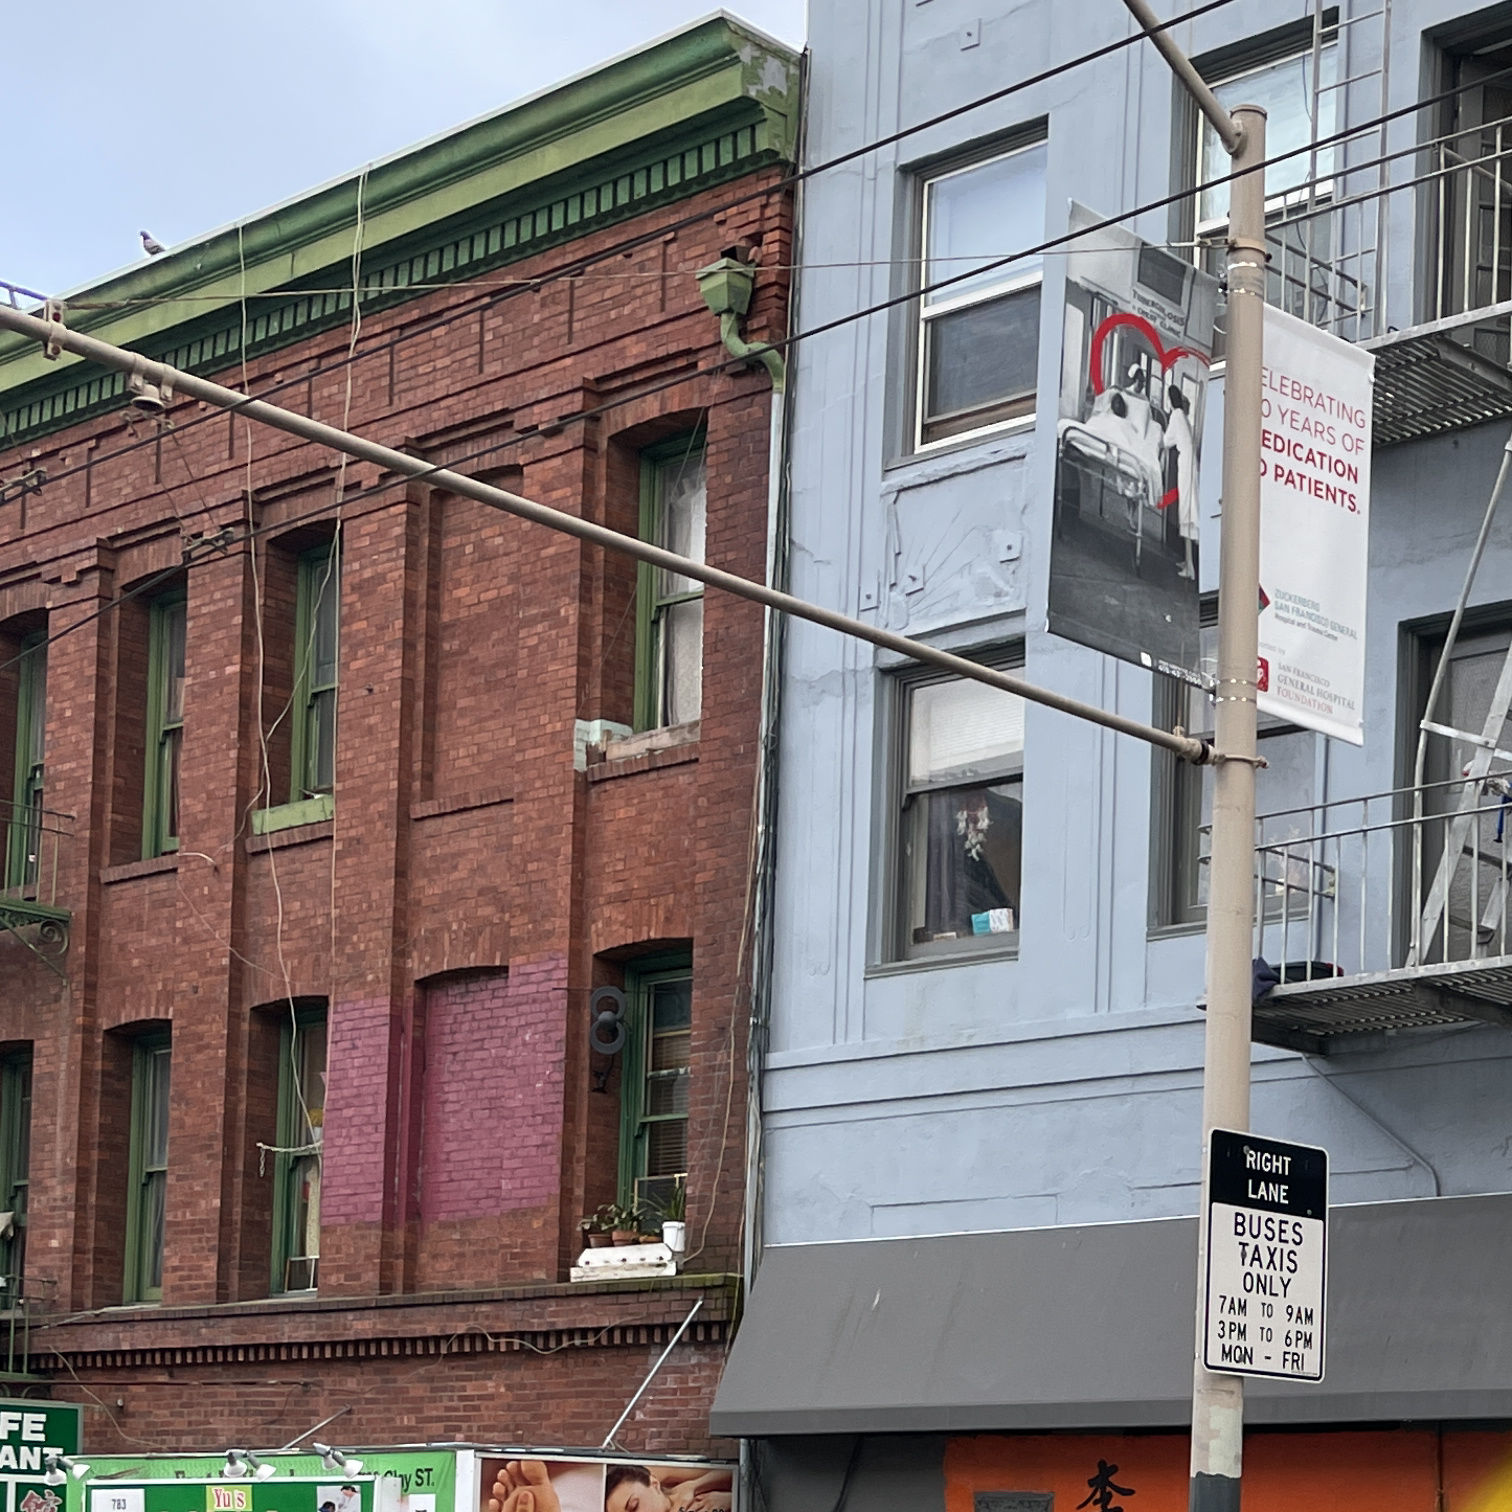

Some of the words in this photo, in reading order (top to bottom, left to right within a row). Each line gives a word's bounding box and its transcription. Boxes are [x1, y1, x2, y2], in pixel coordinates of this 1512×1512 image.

[1261, 366, 1366, 429] ELEBRATING
[1277, 404, 1336, 446] YEARS
[1341, 433, 1365, 456] OF
[1261, 429, 1359, 485] EDICATION
[1274, 464, 1361, 515] PATIENTS.
[1274, 600, 1290, 614] SAN
[1276, 686, 1334, 714] FOUNDATION
[1277, 674, 1315, 696] GENERAL
[1316, 688, 1356, 711] HOSPITAL
[1246, 1150, 1292, 1176] RIGHT
[1248, 1179, 1289, 1205] LANE
[1234, 1212, 1303, 1246] BUSES
[1238, 1242, 1298, 1274] TAXIS
[1242, 1271, 1292, 1299] ONLY
[1218, 1295, 1247, 1317] 7AM
[1261, 1302, 1274, 1319] TO
[1285, 1305, 1314, 1326] 9AM
[1217, 1320, 1247, 1342] 3PM
[1259, 1326, 1273, 1343] TO
[1284, 1329, 1313, 1350] 6PM
[1221, 1343, 1254, 1365] MON
[1282, 1351, 1305, 1371] FRI
[415, 1468, 435, 1488] ST.
[111, 1498, 127, 1510] 783
